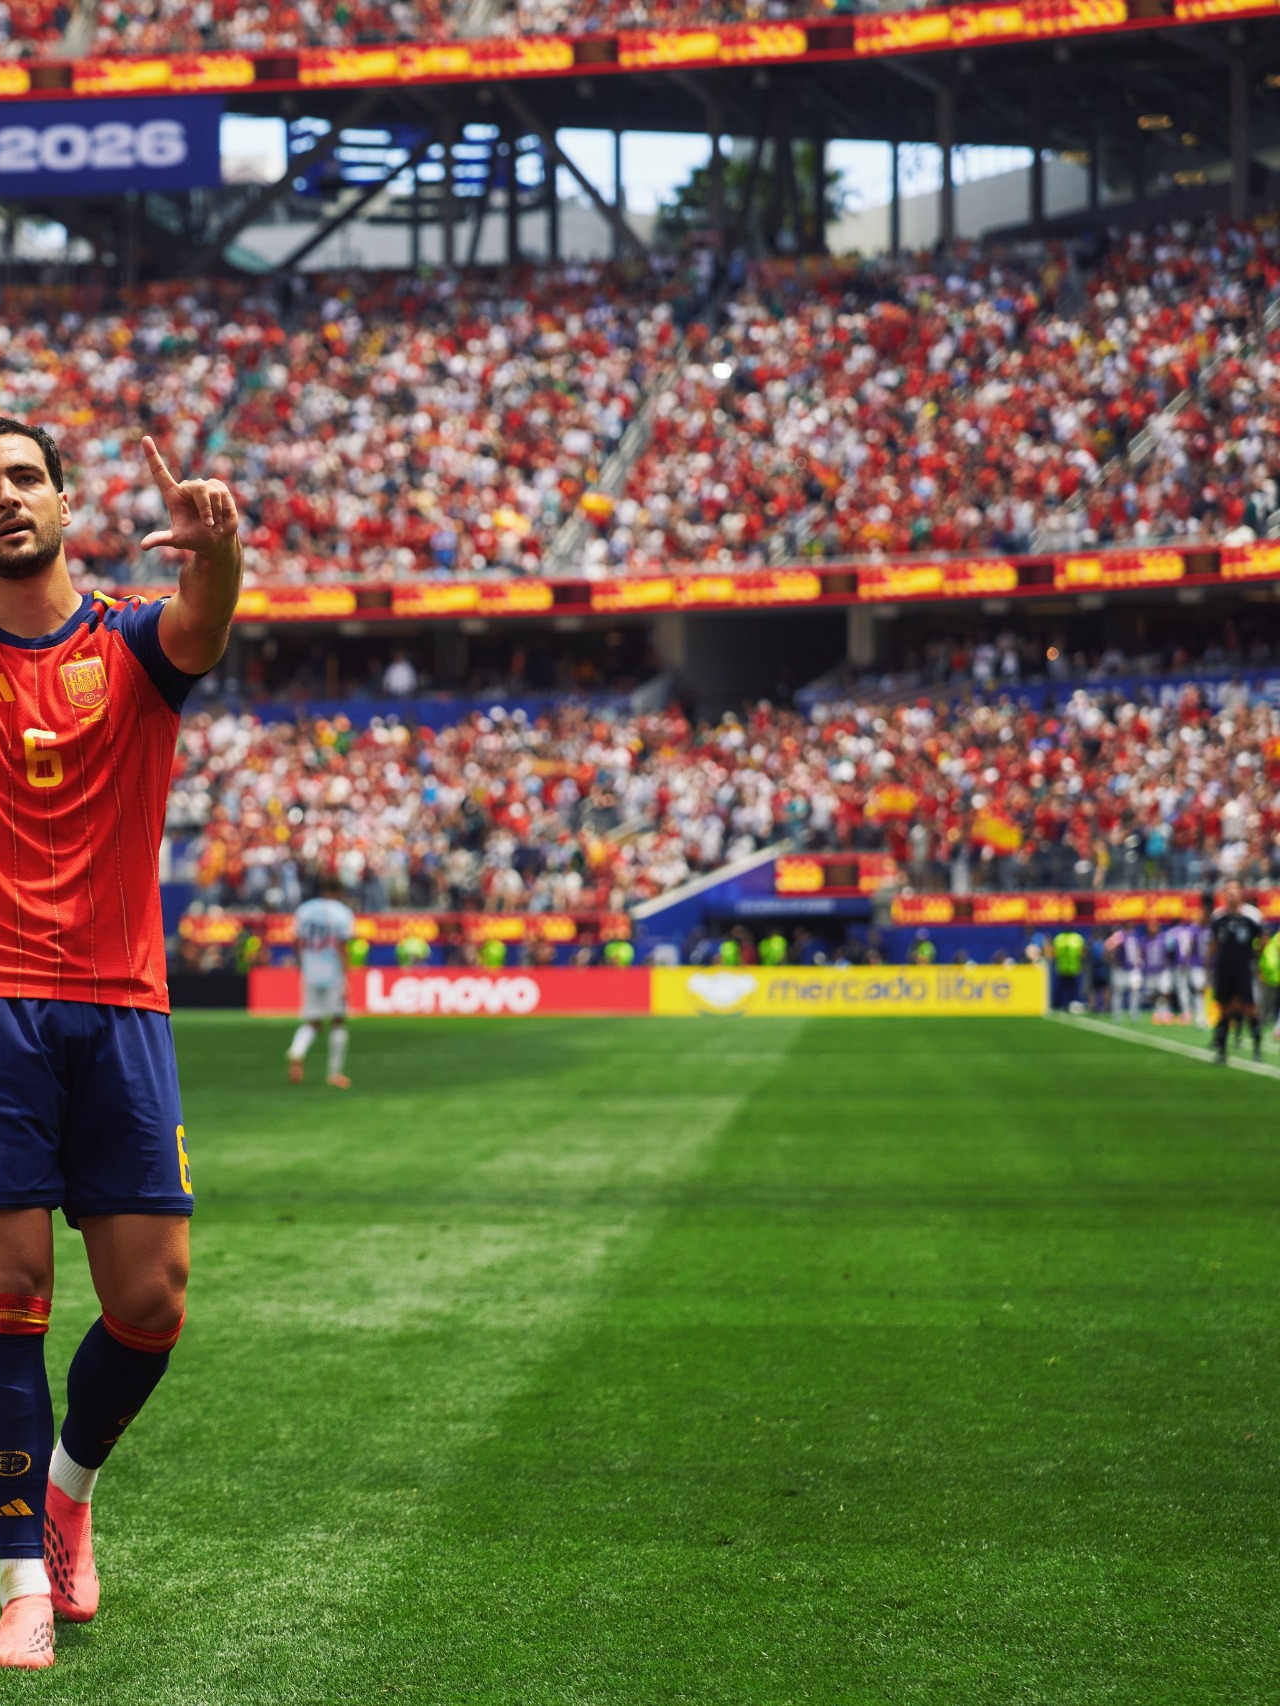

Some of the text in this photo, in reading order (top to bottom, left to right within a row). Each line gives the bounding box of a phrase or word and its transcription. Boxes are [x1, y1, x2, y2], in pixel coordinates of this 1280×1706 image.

[23, 728, 64, 788] 6
[365, 969, 541, 1014] Lenovo
[768, 968, 1012, 1002] mercado libre
